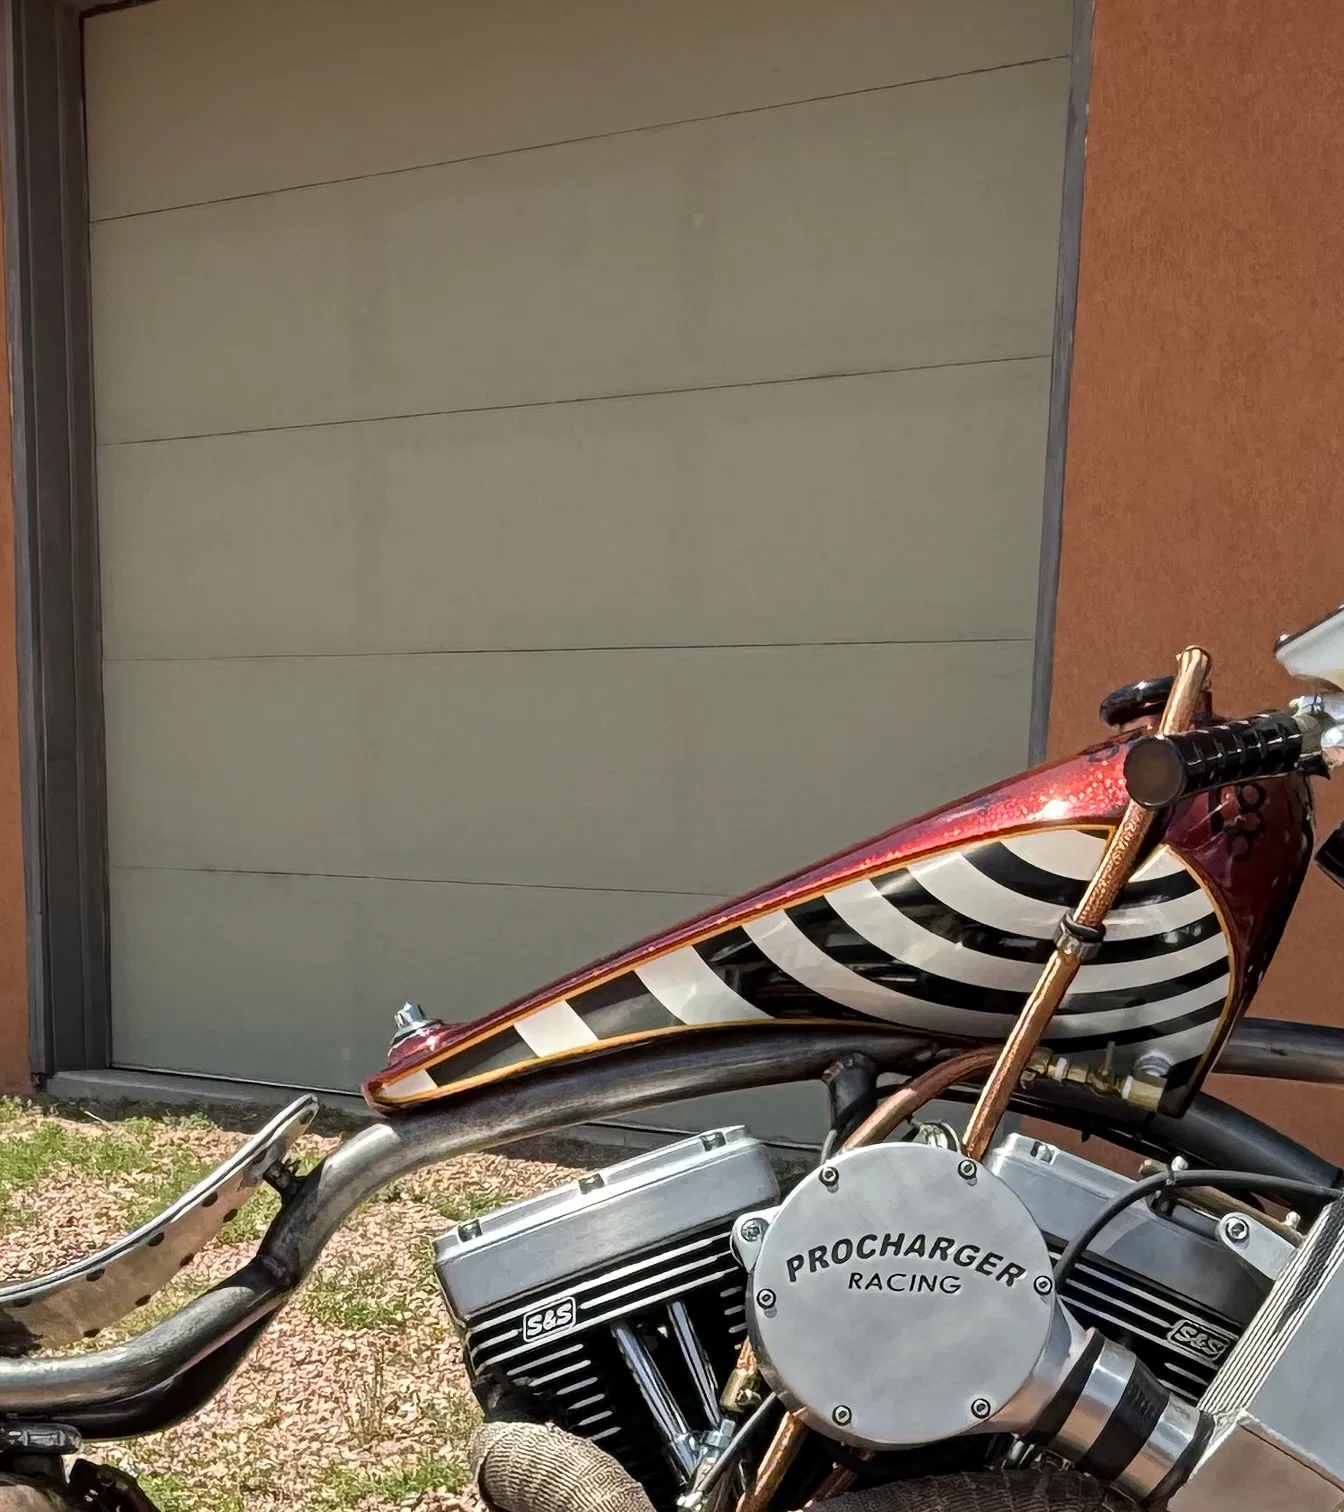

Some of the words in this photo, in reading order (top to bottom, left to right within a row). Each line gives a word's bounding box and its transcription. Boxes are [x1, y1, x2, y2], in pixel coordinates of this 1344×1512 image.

[786, 1233, 1026, 1287] PROCHARGER
[848, 1273, 961, 1294] RACING
[526, 1303, 573, 1337] S&S
